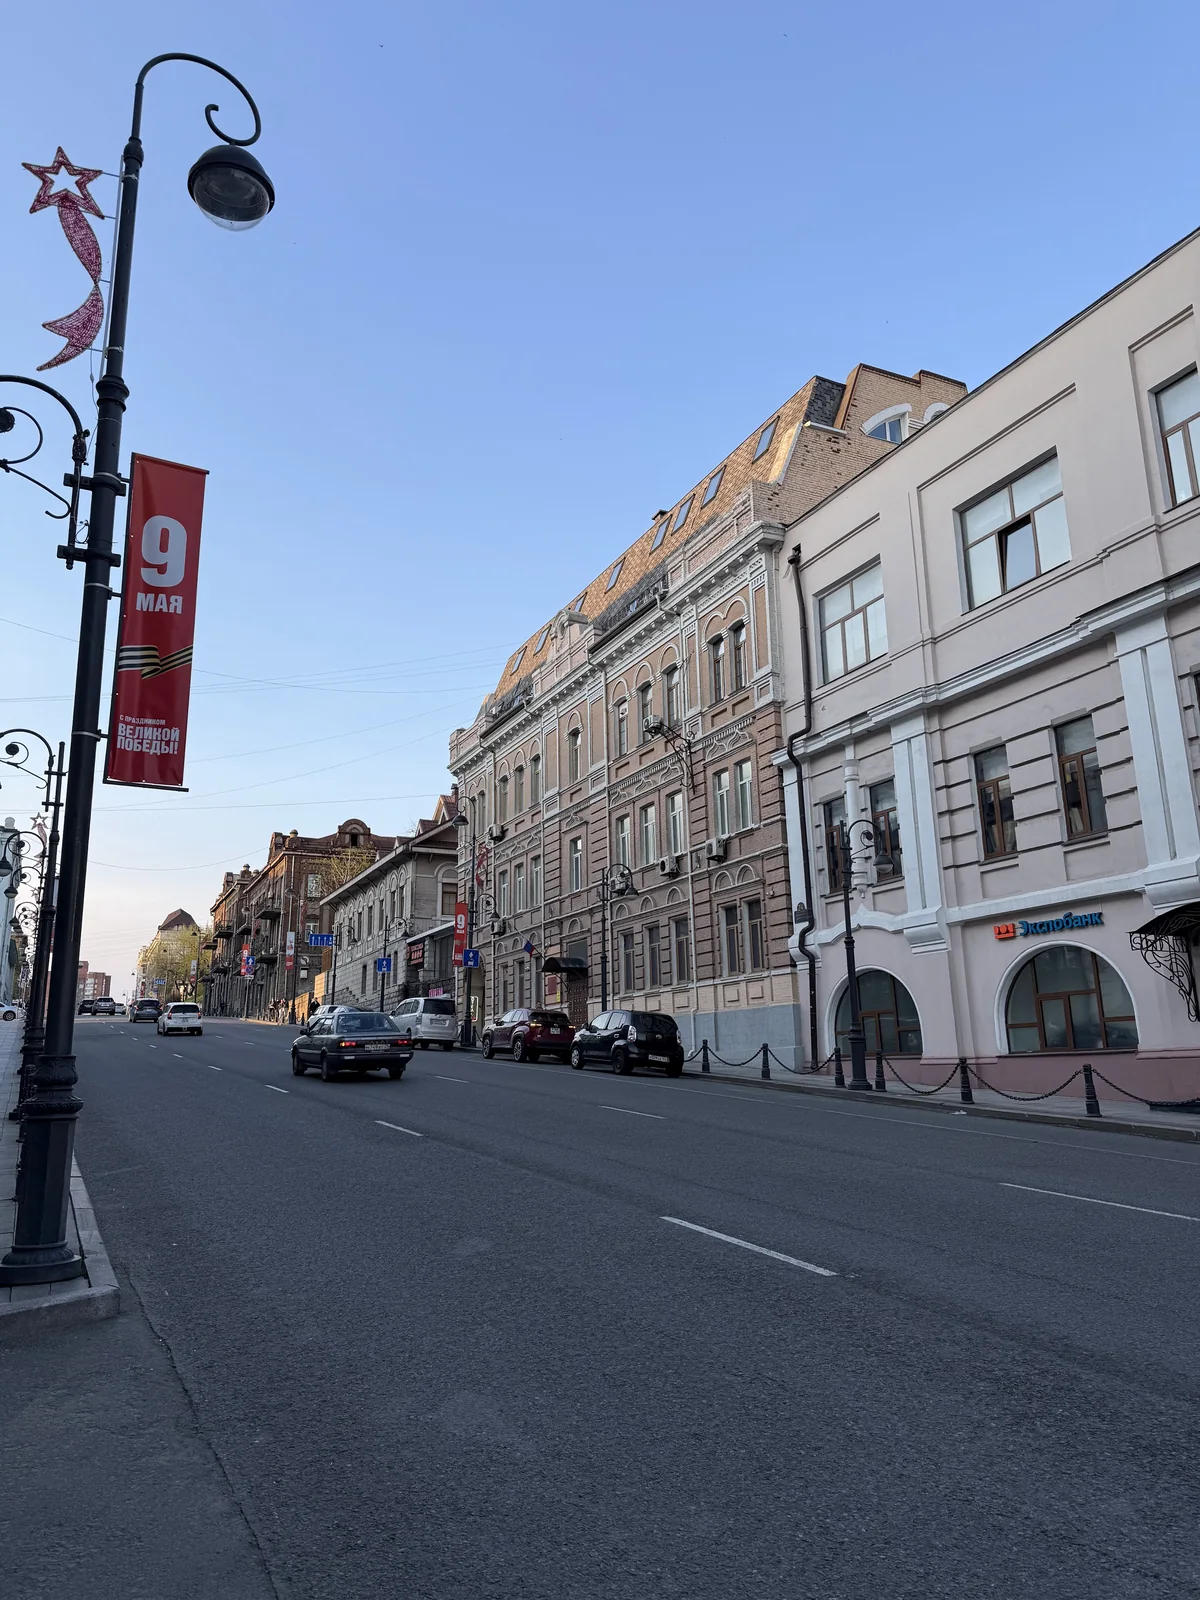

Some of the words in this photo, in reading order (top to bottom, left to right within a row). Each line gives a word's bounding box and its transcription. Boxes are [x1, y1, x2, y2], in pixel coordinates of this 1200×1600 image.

[141, 515, 188, 588] 9
[136, 592, 183, 615] МАЯ
[125, 715, 166, 726] ПРАЗДНИКОМ
[117, 722, 180, 742] ВЕЛИКОЙ
[116, 735, 179, 756] ПОБЕДЫ!
[456, 914, 466, 929] 9
[1018, 911, 1104, 937] Экспобанк
